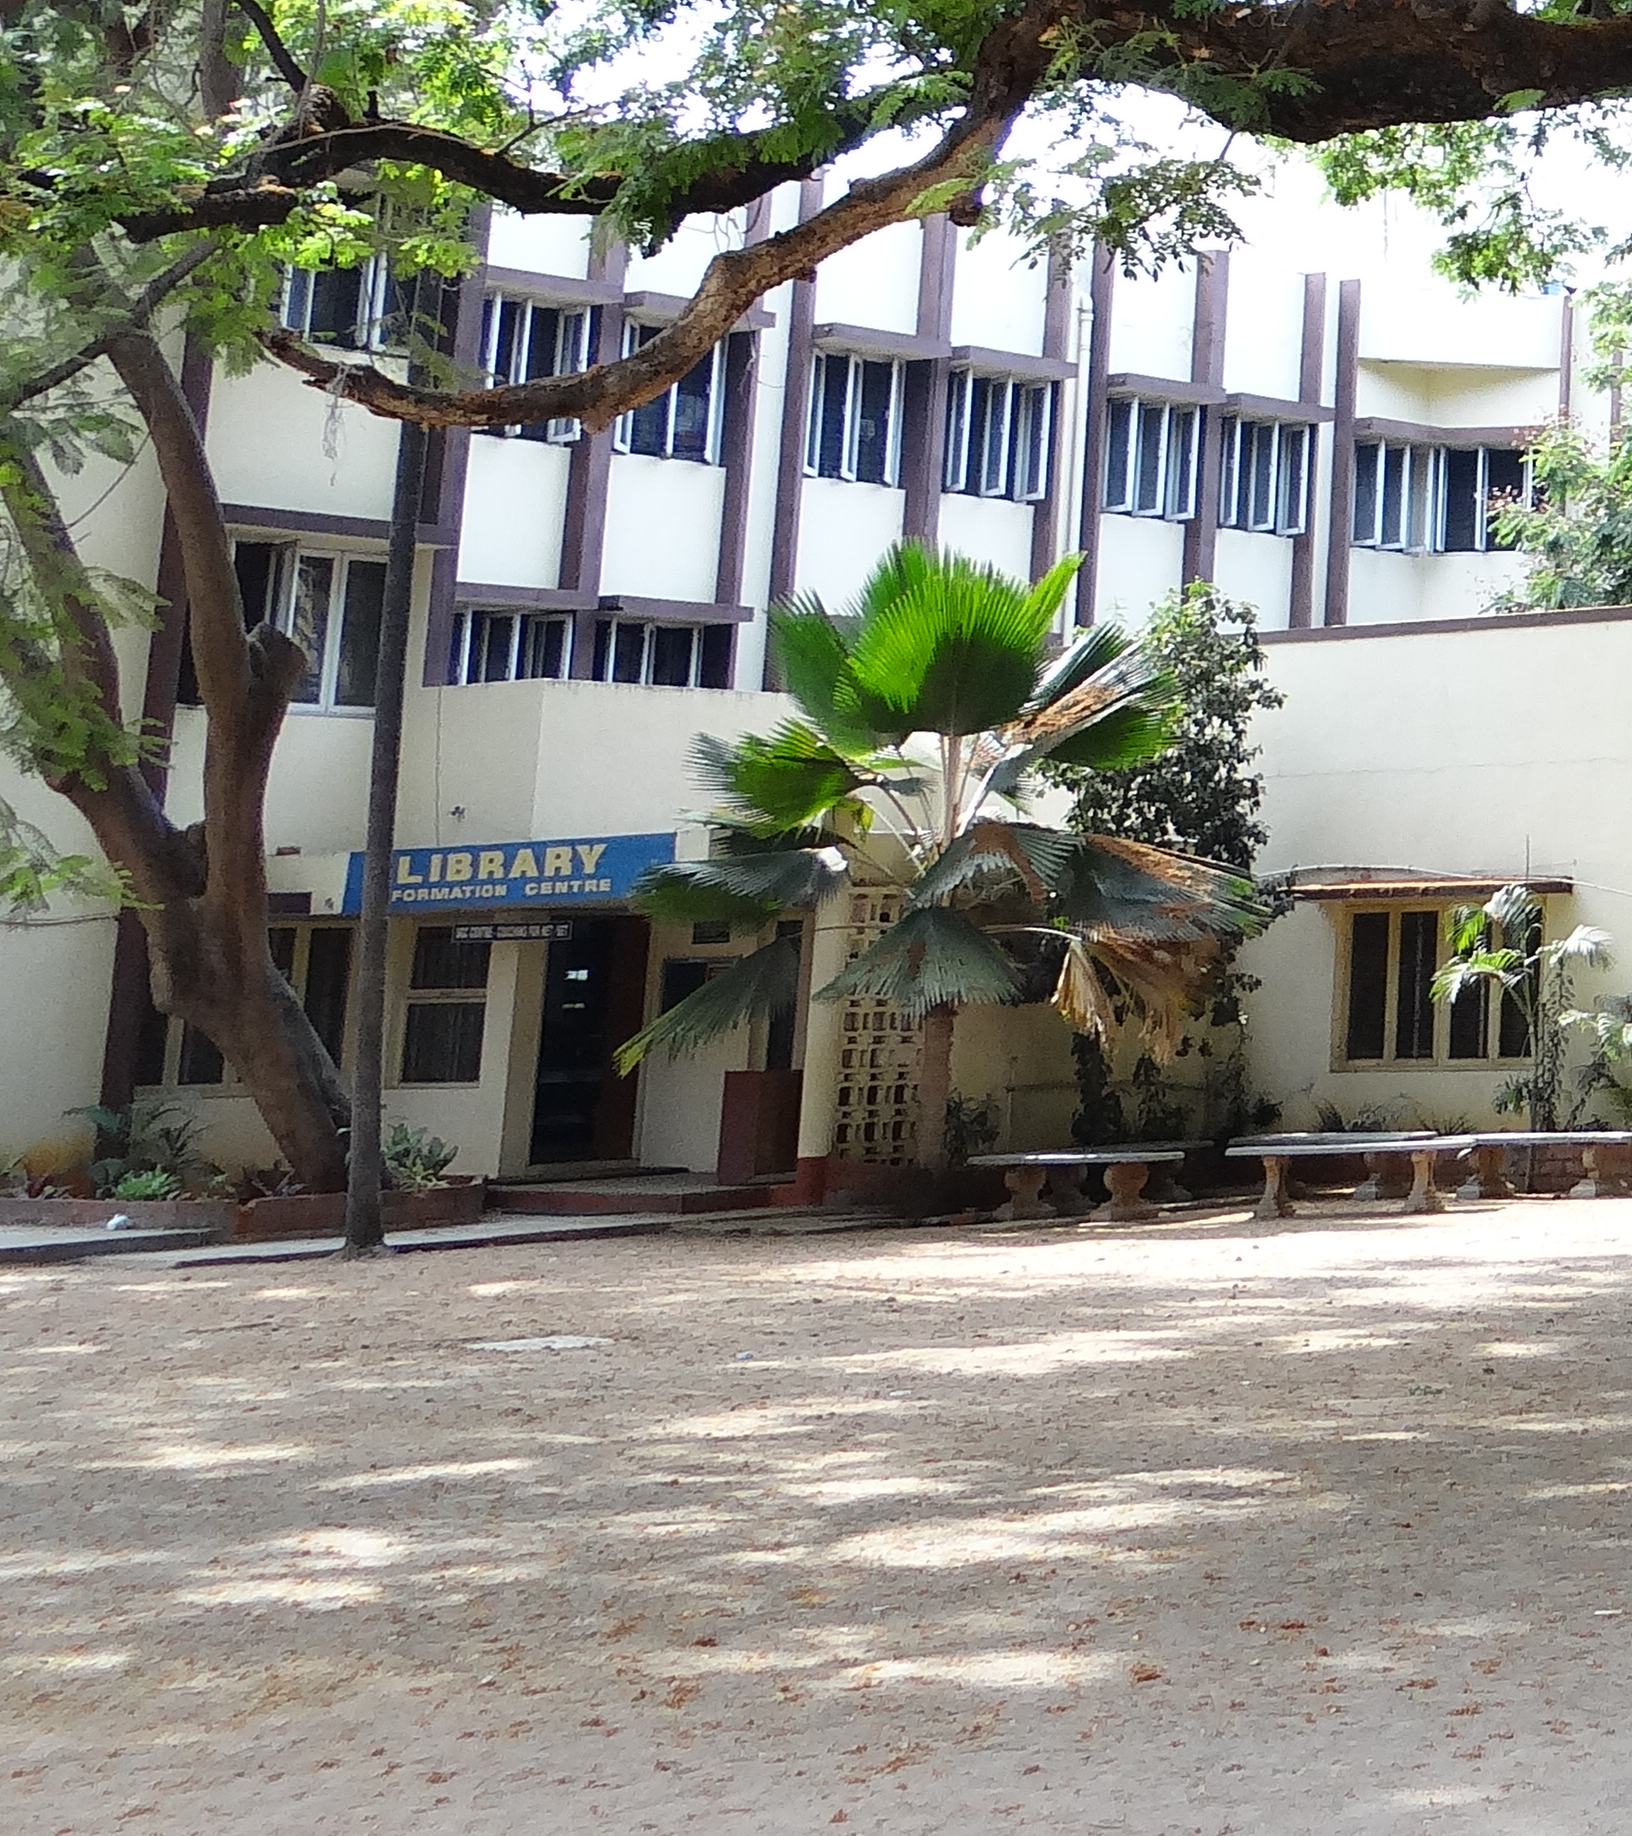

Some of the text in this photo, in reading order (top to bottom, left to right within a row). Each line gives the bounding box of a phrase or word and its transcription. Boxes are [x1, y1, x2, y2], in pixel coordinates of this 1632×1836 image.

[396, 843, 608, 884] LIBRARY
[391, 878, 612, 903] FORMATION CENTRE
